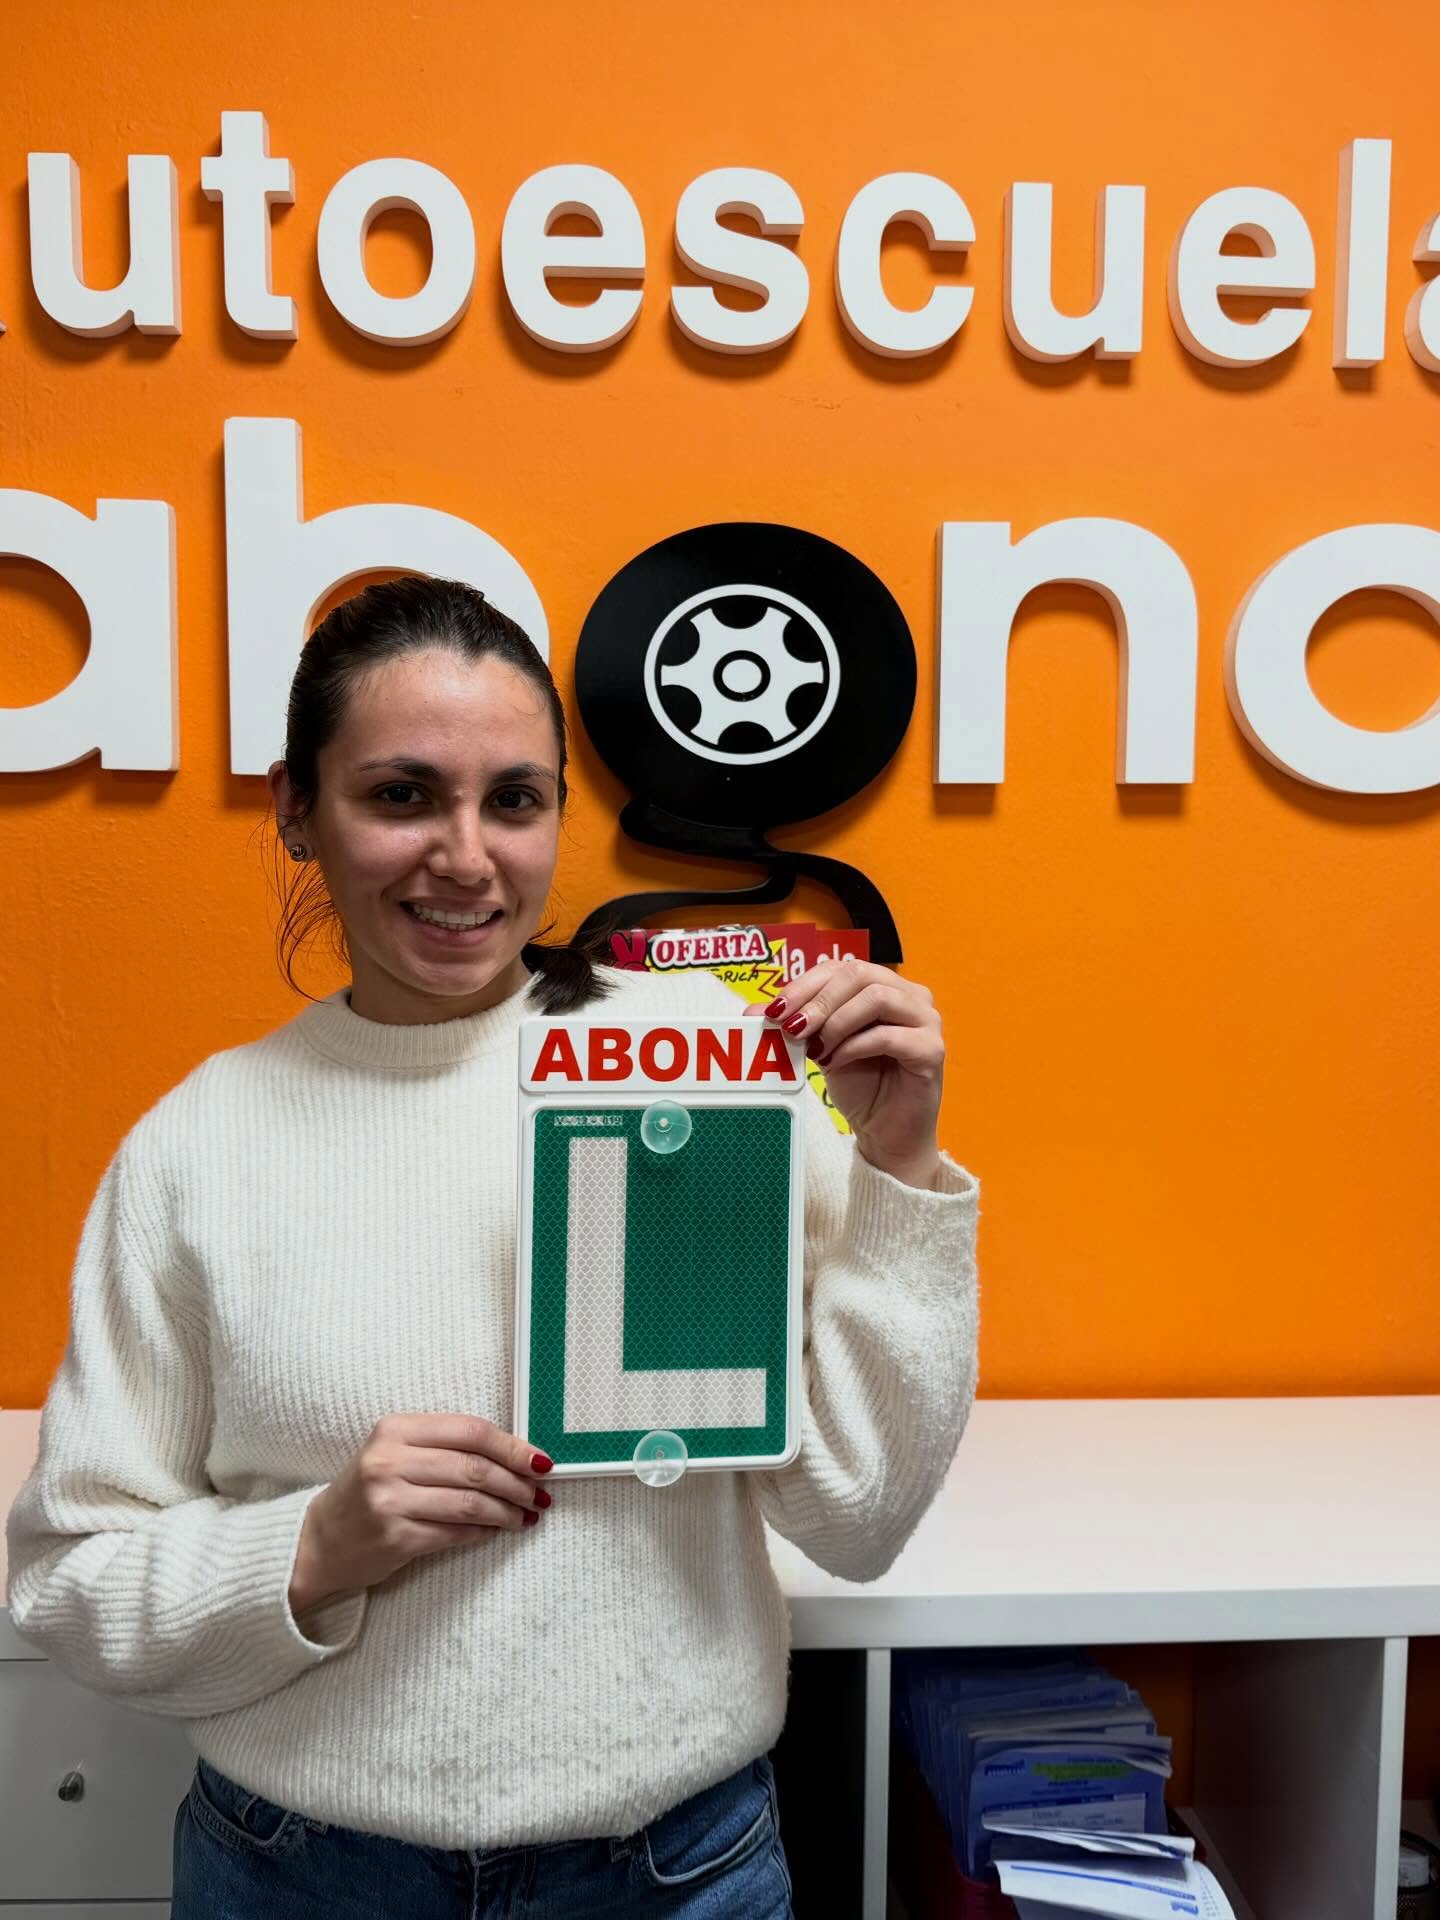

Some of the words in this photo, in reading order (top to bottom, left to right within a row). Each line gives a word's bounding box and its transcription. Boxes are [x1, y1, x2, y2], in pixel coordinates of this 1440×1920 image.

[0, 111, 1440, 373] utoescuel
[655, 932, 765, 963] OFERTA
[530, 1027, 797, 1082] ABONA
[563, 1136, 767, 1434] L
